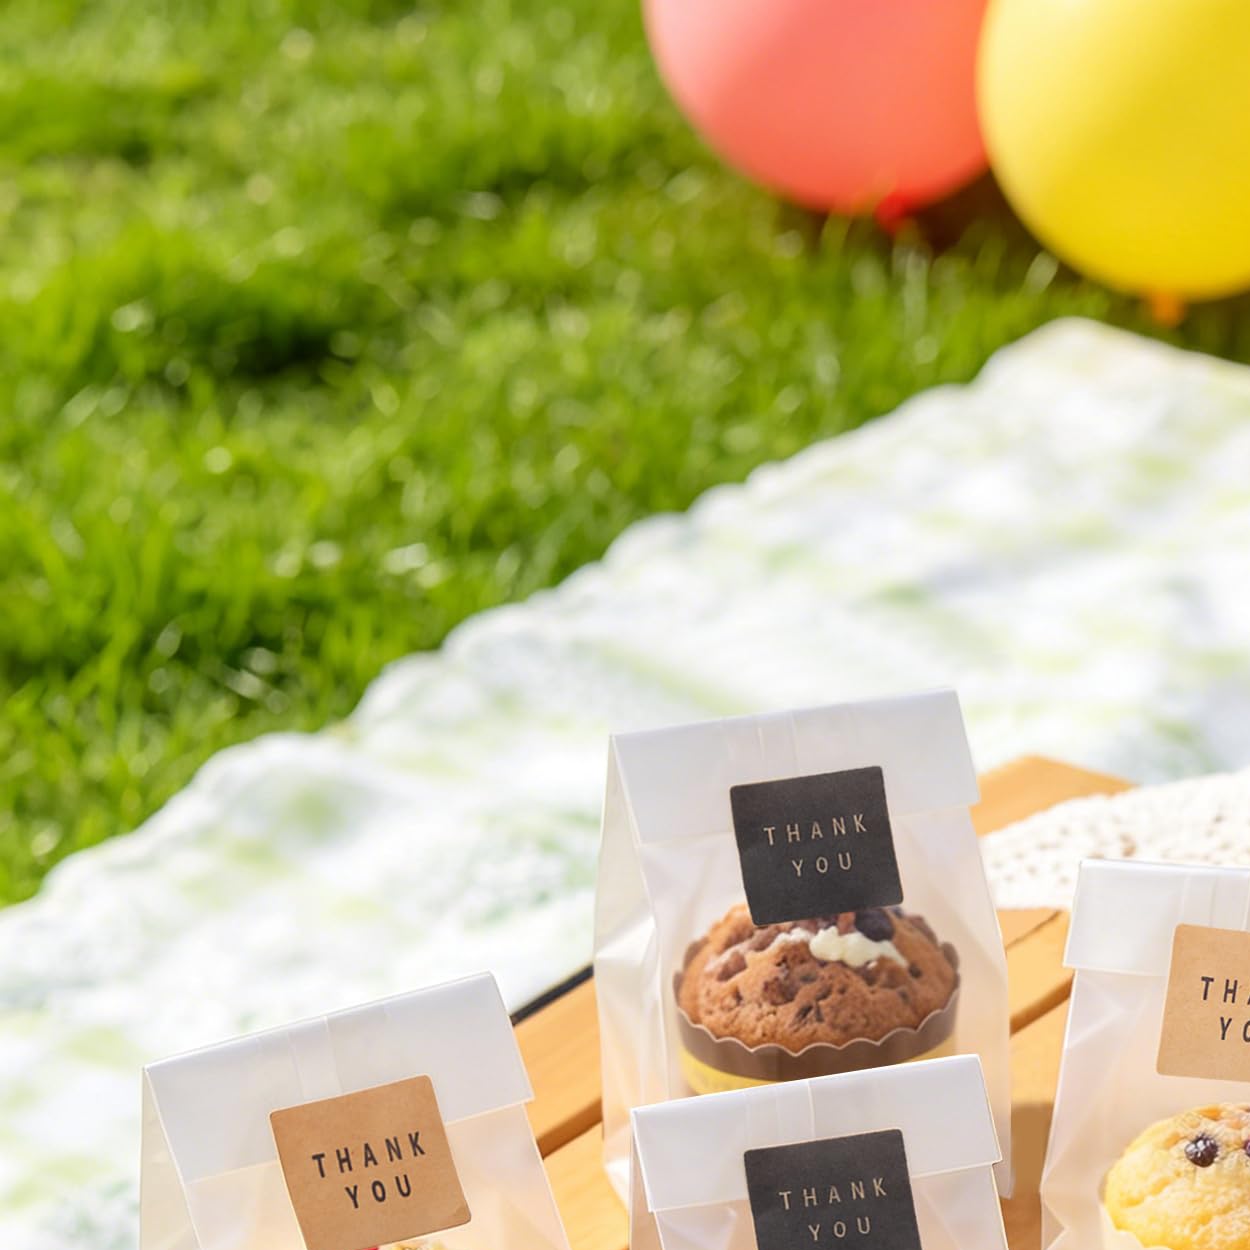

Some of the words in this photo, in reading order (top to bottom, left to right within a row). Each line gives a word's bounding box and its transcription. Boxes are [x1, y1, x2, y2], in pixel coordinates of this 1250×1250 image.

[763, 813, 867, 846] THANK
[791, 852, 852, 877] YOU
[311, 1131, 426, 1179] THANK
[344, 1173, 412, 1209] YOU
[778, 1177, 887, 1210] THANK
[808, 1216, 871, 1241] YOU
